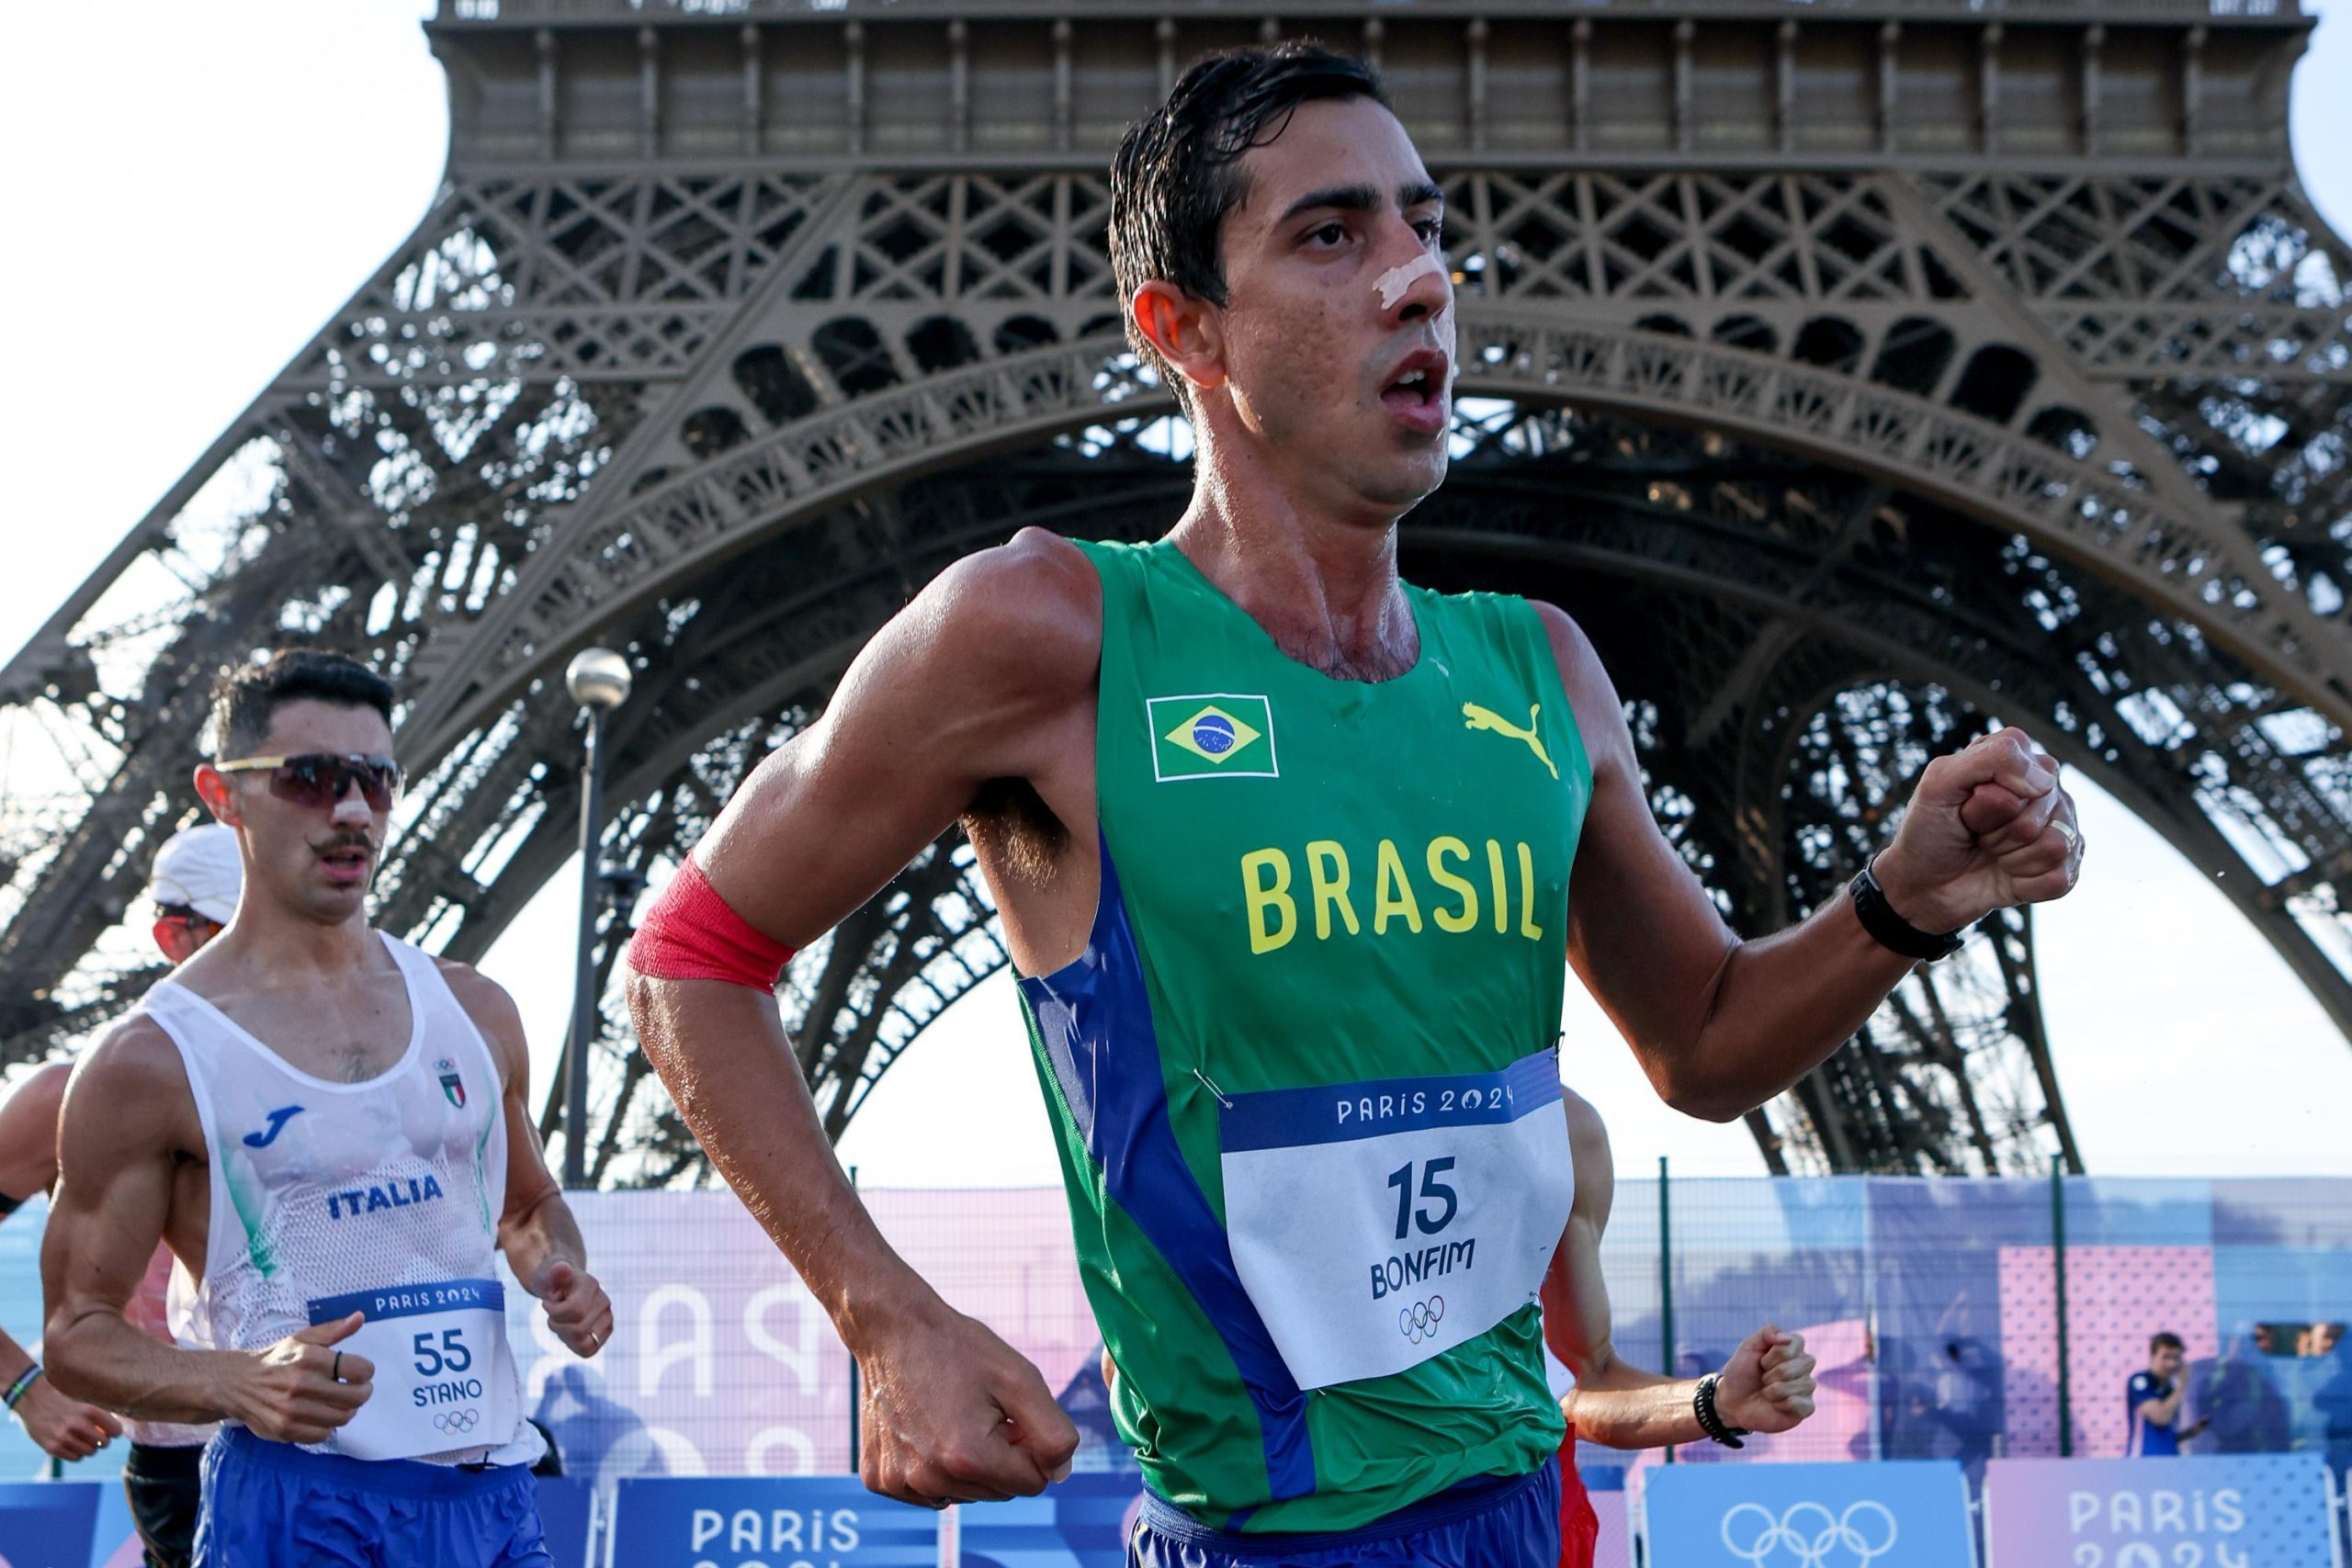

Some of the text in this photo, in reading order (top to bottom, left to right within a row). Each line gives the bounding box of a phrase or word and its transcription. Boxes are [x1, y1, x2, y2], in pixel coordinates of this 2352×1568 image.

[1240, 835, 1544, 954] BRASIL
[1439, 1084, 1514, 1111] 2024
[327, 1175, 443, 1219] ITALIA
[1387, 1156, 1458, 1240] 15
[1370, 1238, 1476, 1300] BONFIM
[435, 1287, 480, 1303] 2024
[414, 1328, 471, 1377] 55
[413, 1379, 482, 1407] STANO
